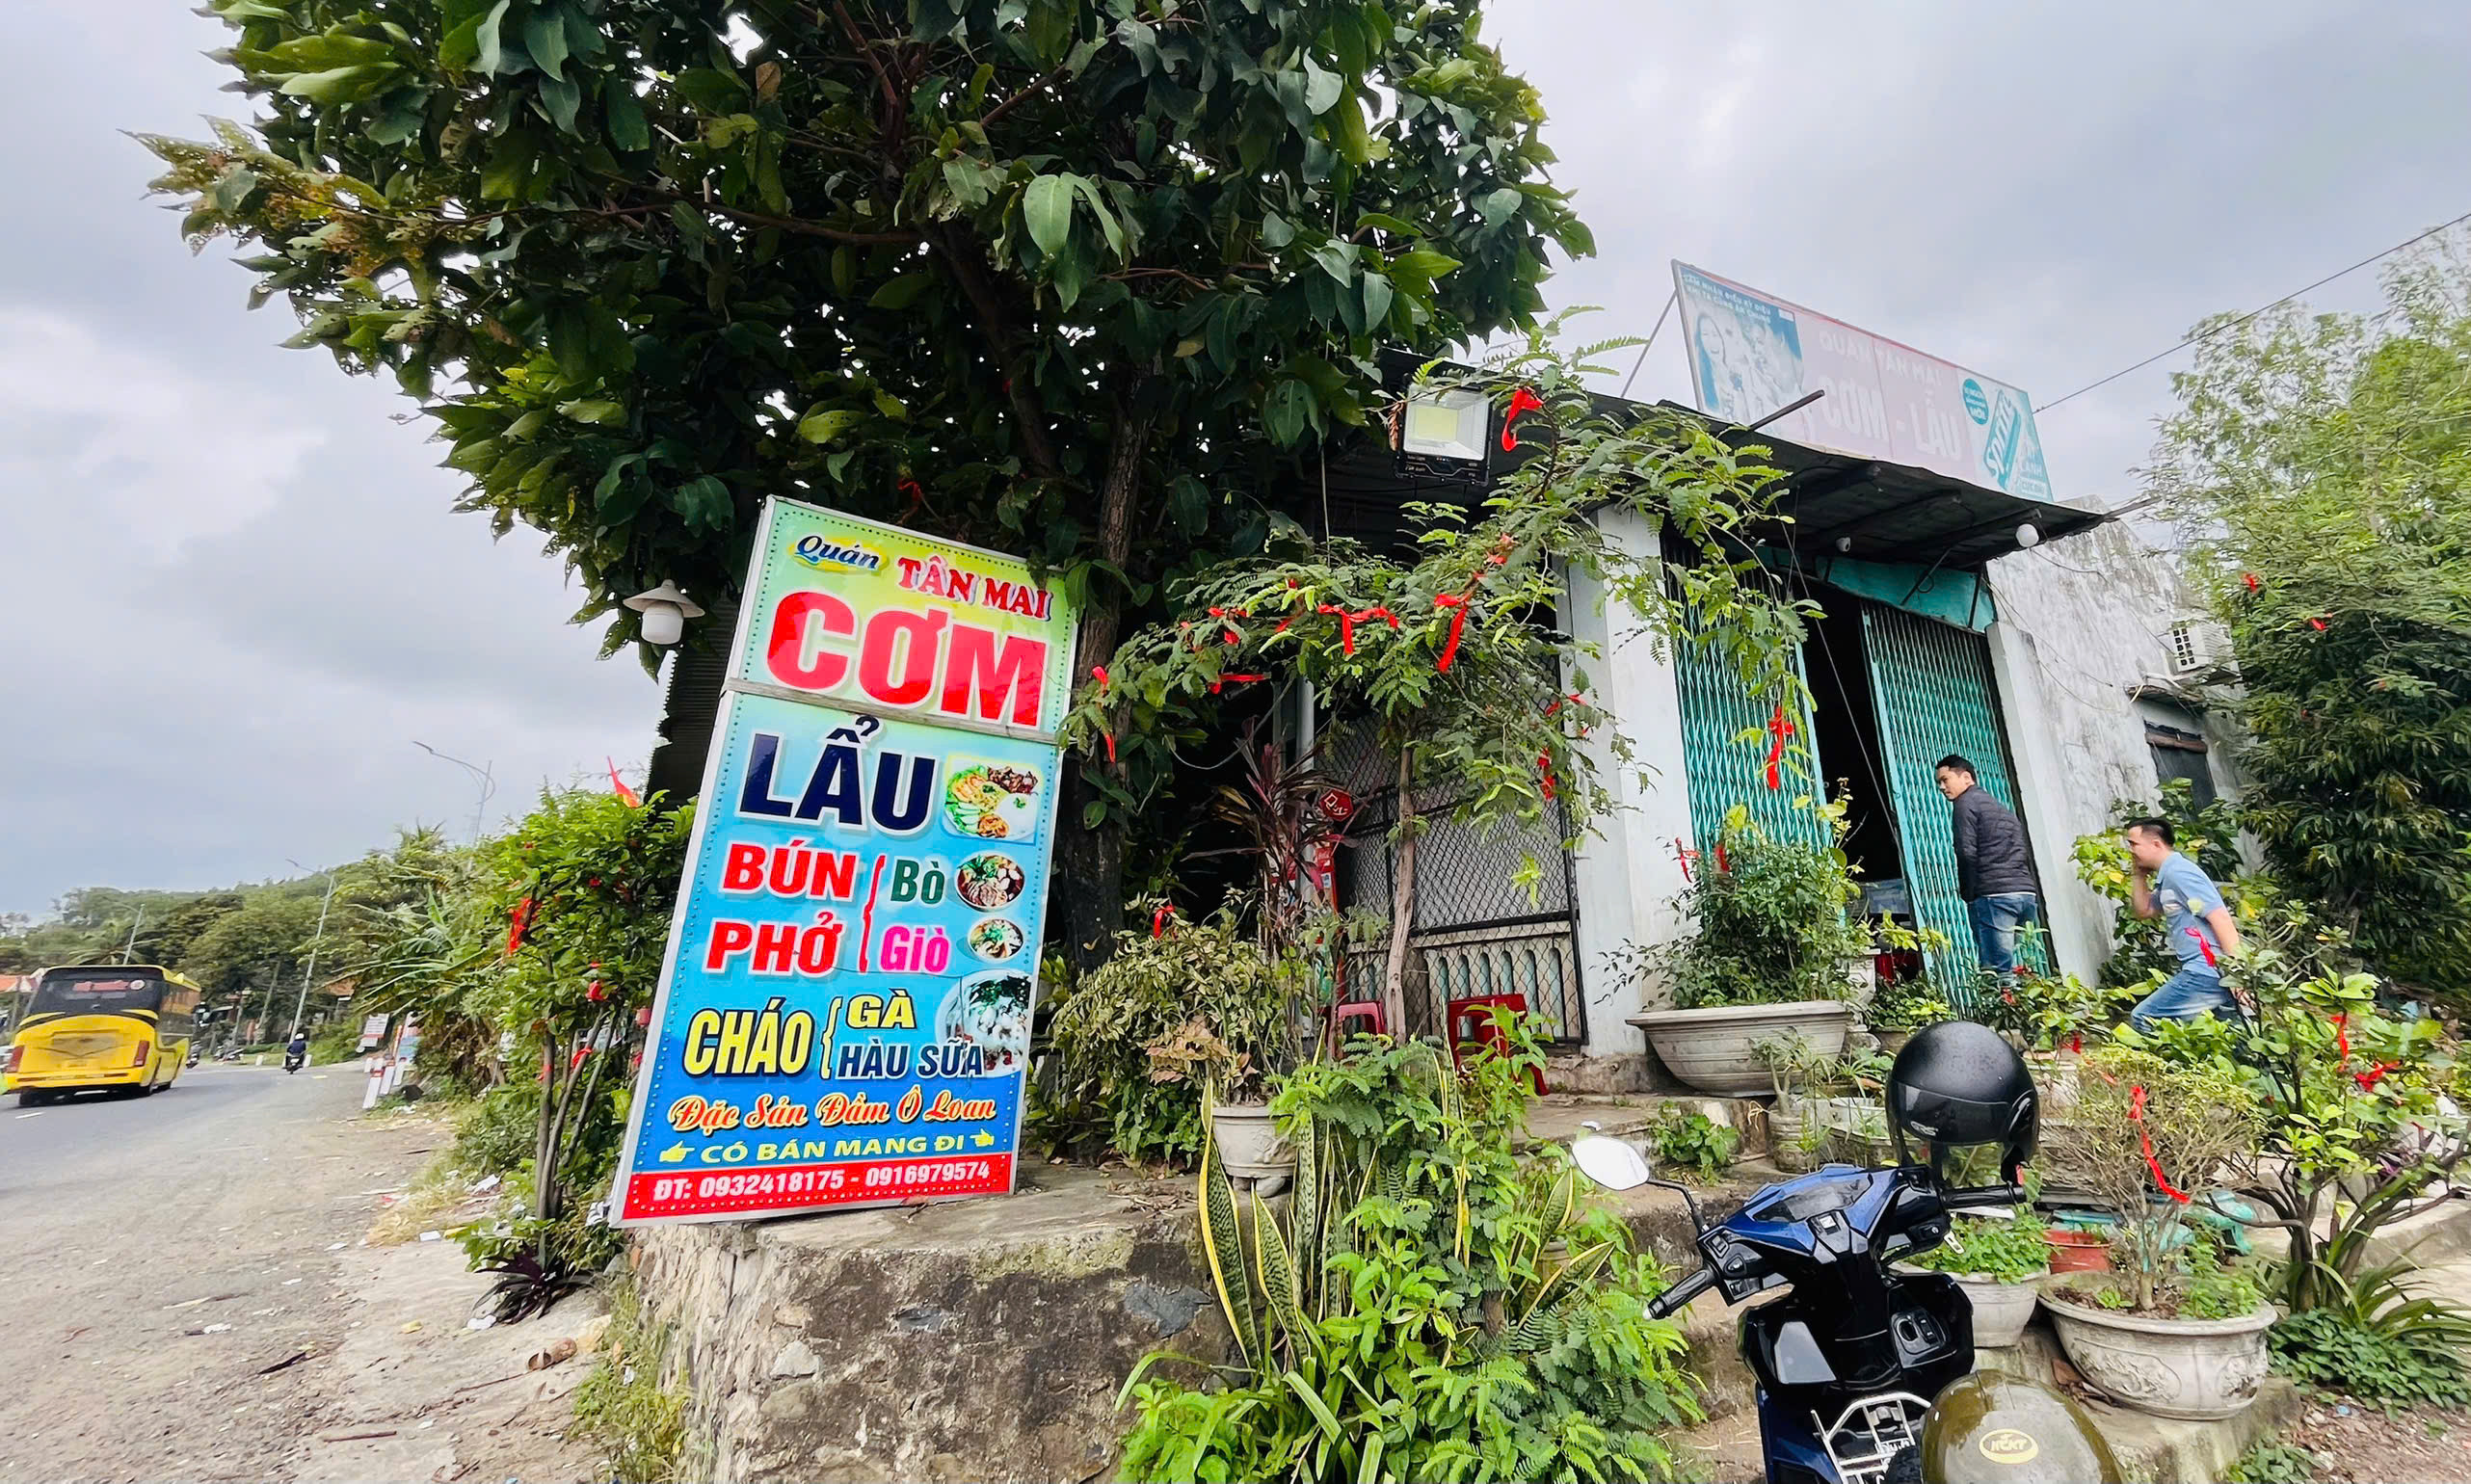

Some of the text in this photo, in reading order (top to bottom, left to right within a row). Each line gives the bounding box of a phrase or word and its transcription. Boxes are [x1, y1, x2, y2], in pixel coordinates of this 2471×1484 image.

[796, 536, 1052, 620] Quán TÂN MAI
[767, 591, 1047, 727] CƠM
[739, 715, 936, 832] LẨU
[723, 839, 945, 904] BÚN Bò
[706, 911, 950, 974] PHỞ Giò
[685, 988, 917, 1076] CHÁO GÀ
[837, 1036, 985, 1079] HÀU SỮA
[668, 1084, 996, 1137] Đặc Sản Đầm Ô Loan
[652, 1178, 693, 1202] ĐT:
[699, 1168, 845, 1198] 0932418175
[864, 1160, 990, 1187] 0916979574
[701, 1135, 965, 1163] CÓ BÁN MANG ĐI
